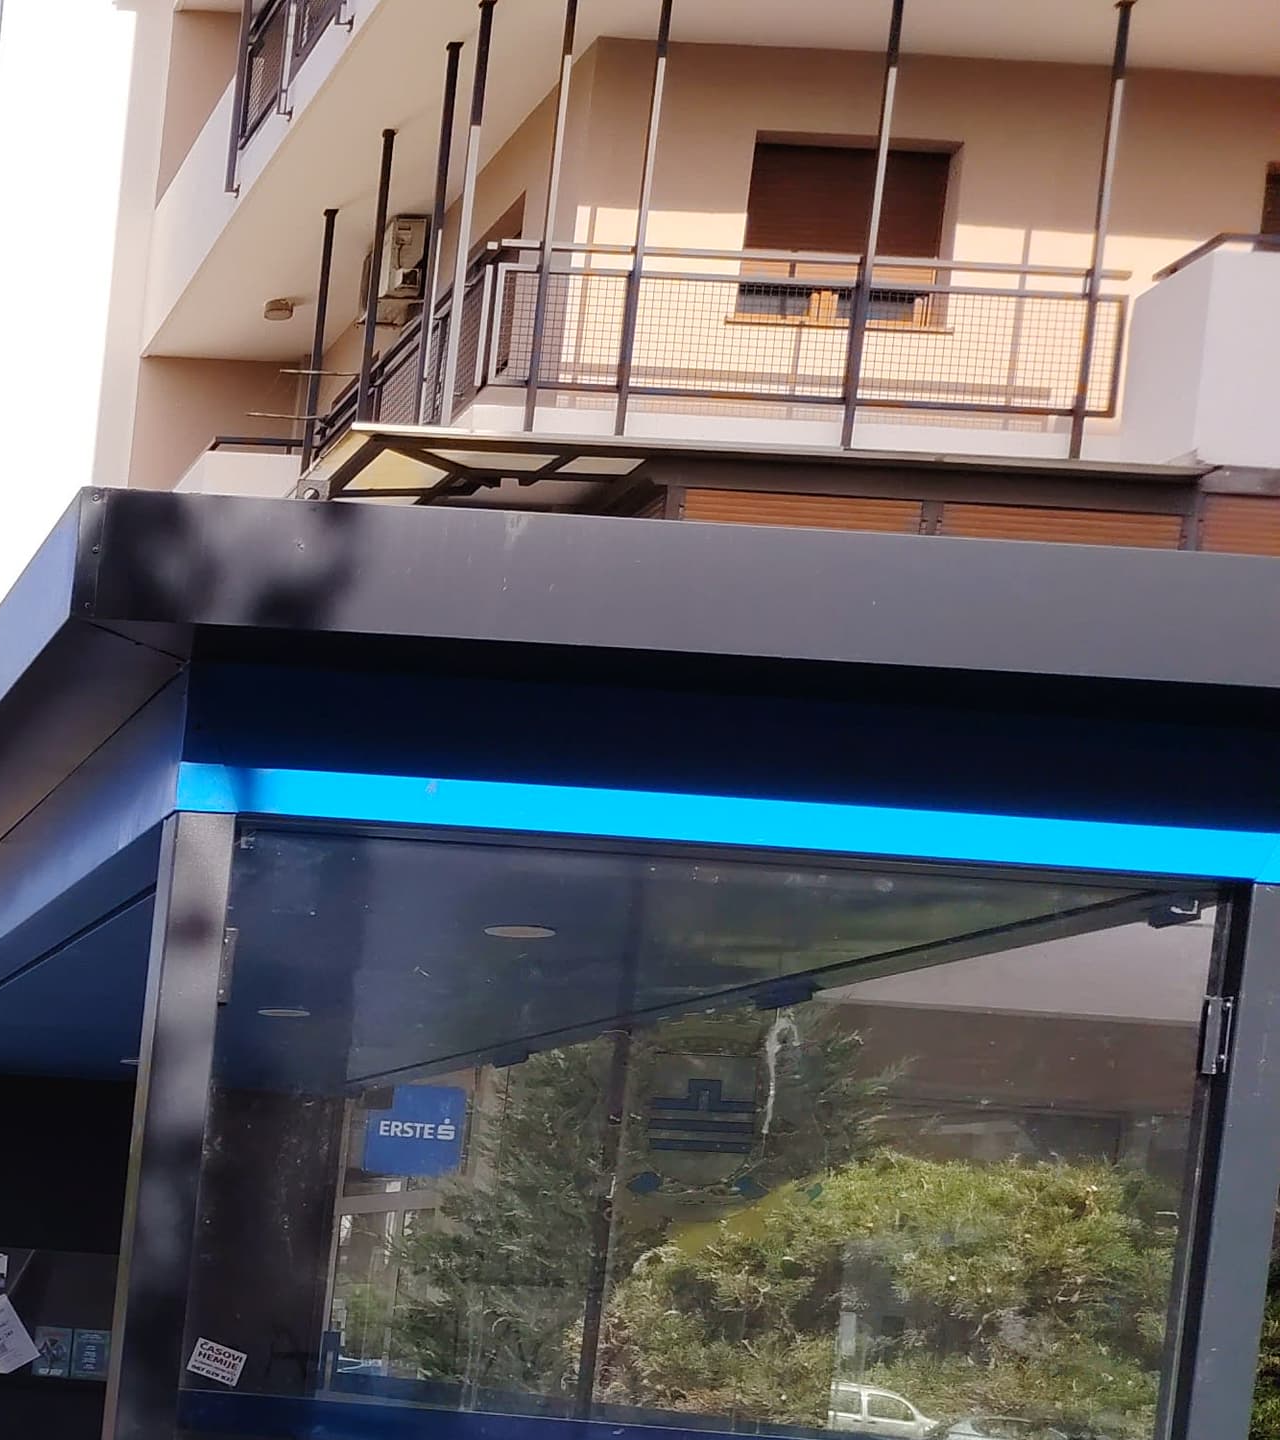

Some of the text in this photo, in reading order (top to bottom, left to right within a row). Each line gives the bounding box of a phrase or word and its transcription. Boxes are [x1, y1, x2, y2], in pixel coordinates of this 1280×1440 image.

[379, 1120, 436, 1139] ERSTE
[197, 1350, 239, 1371] HEMIJE
[199, 1341, 243, 1363] ČASOVI
